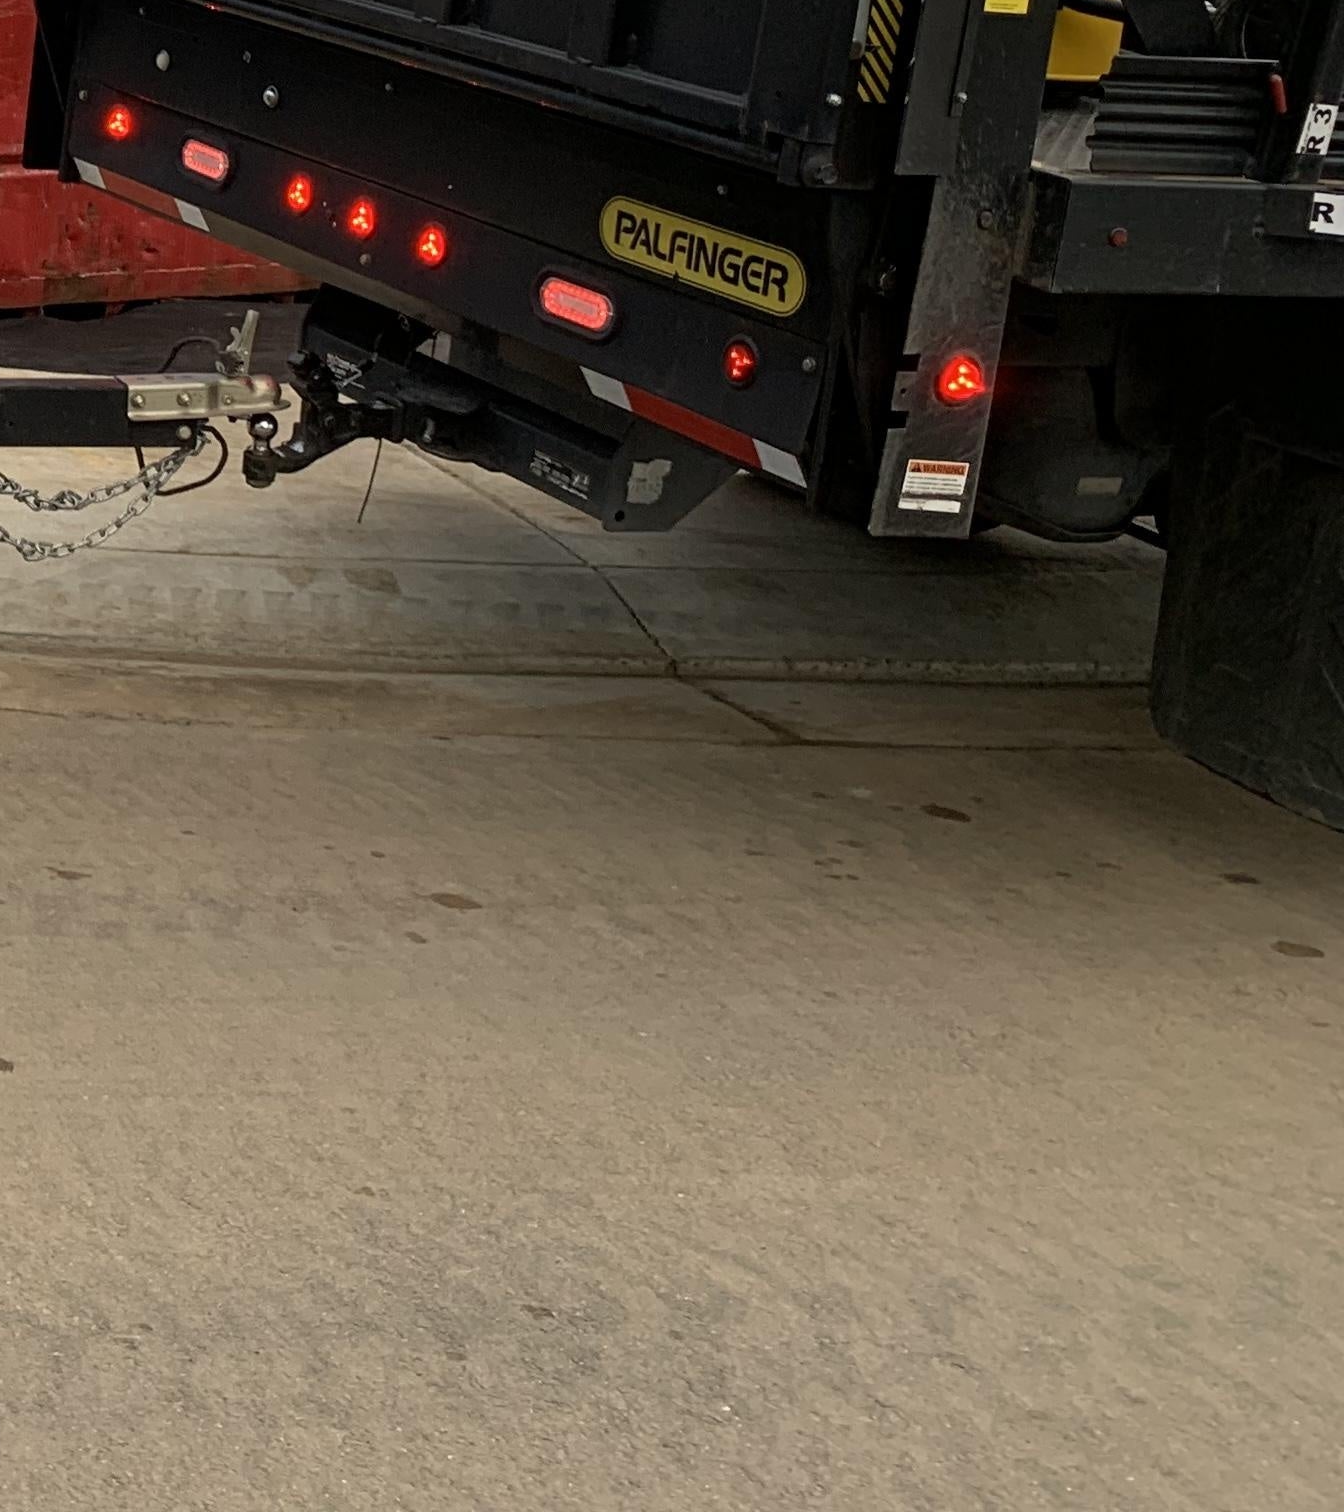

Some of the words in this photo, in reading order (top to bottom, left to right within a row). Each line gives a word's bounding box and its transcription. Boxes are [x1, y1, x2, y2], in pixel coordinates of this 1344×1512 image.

[1314, 109, 1332, 125] 3
[1312, 201, 1335, 224] R
[614, 209, 789, 303] PALFINGER
